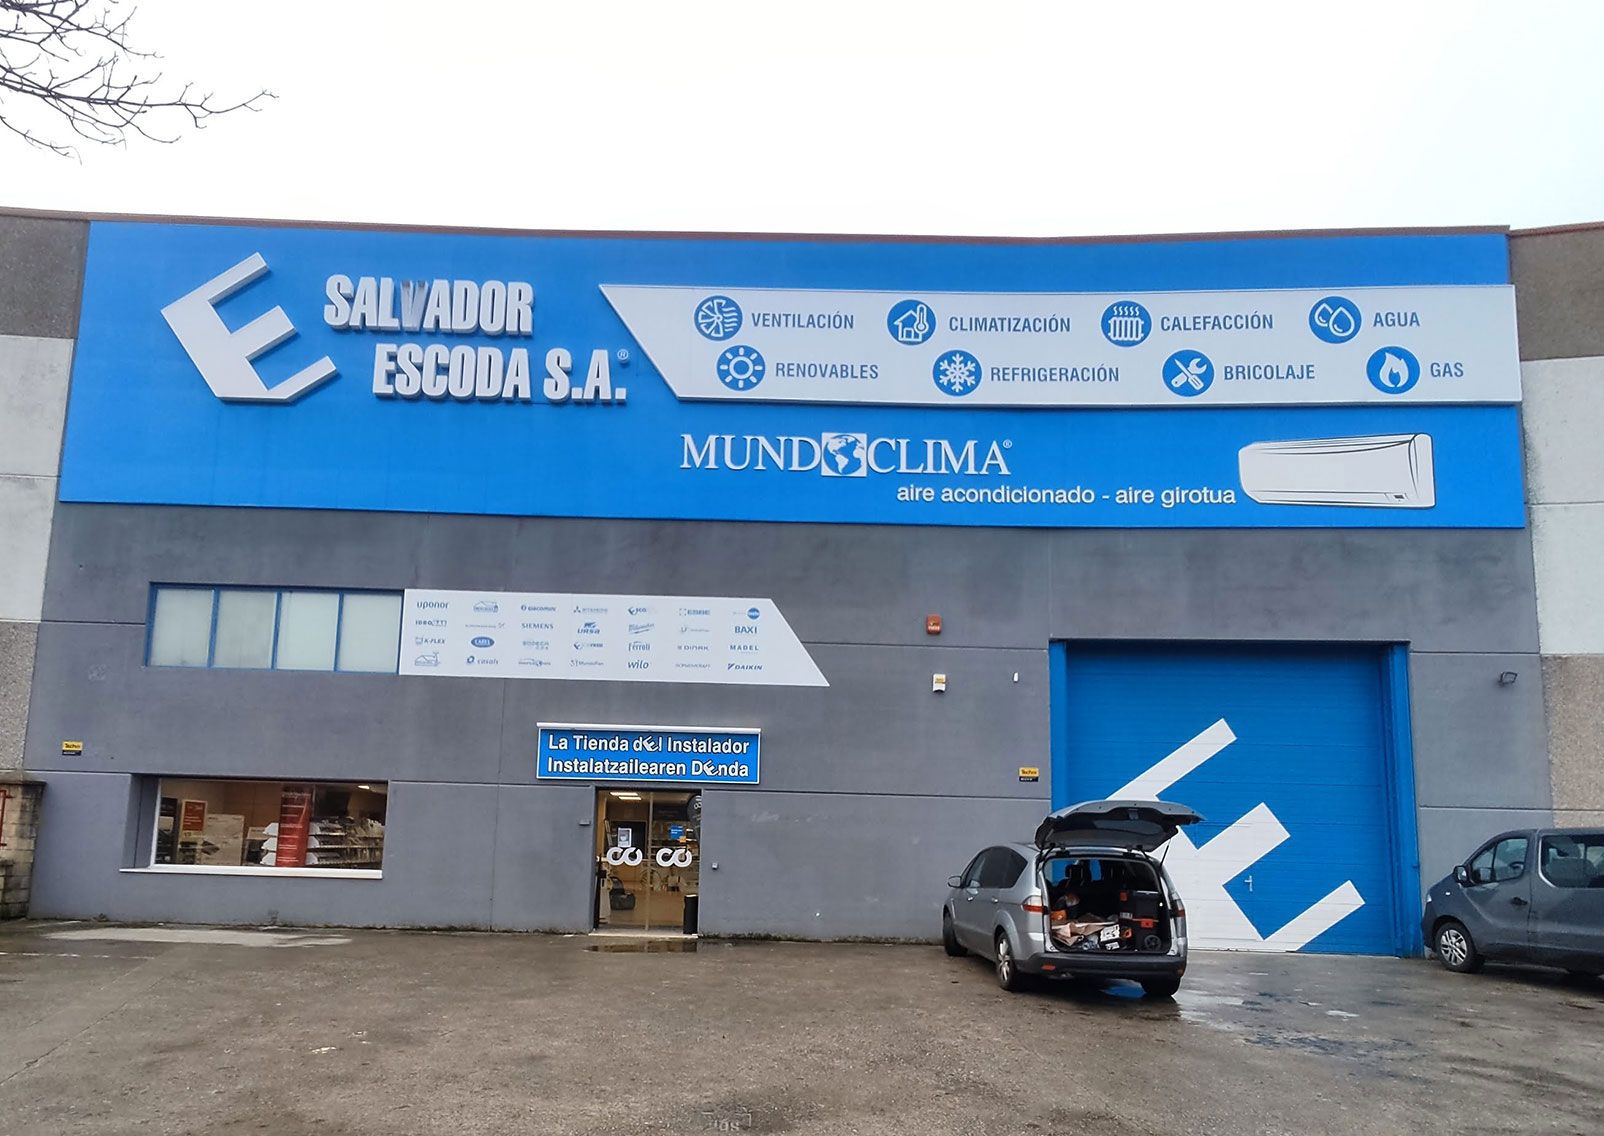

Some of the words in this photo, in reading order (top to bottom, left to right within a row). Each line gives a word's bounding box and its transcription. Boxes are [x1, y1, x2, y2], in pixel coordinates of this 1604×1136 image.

[323, 274, 534, 336] SALVADOR
[751, 310, 854, 330] VENTILACIÓN
[948, 315, 1071, 334] CLIMATIZACIÓN
[1160, 310, 1274, 332] CALEFACCIÓN
[1373, 311, 1420, 328] AGUA
[373, 343, 532, 399] ESCODA
[775, 361, 879, 380] RENOVABLES
[990, 364, 1120, 383] REFRIGERACIÓN
[1223, 364, 1315, 381] BRICOLAJE
[1430, 361, 1464, 379] GAS
[897, 484, 934, 502] aire
[941, 484, 1095, 504] acondicionado
[1115, 484, 1155, 504] aire
[1161, 485, 1237, 508] girotua
[521, 622, 554, 630] SIEMENS
[734, 625, 758, 634] BAXI
[627, 659, 649, 670] wilo
[548, 734, 568, 750] La
[572, 734, 629, 752] Tienda
[667, 736, 750, 754] Instalador
[547, 756, 686, 776] Instalatzailearen
